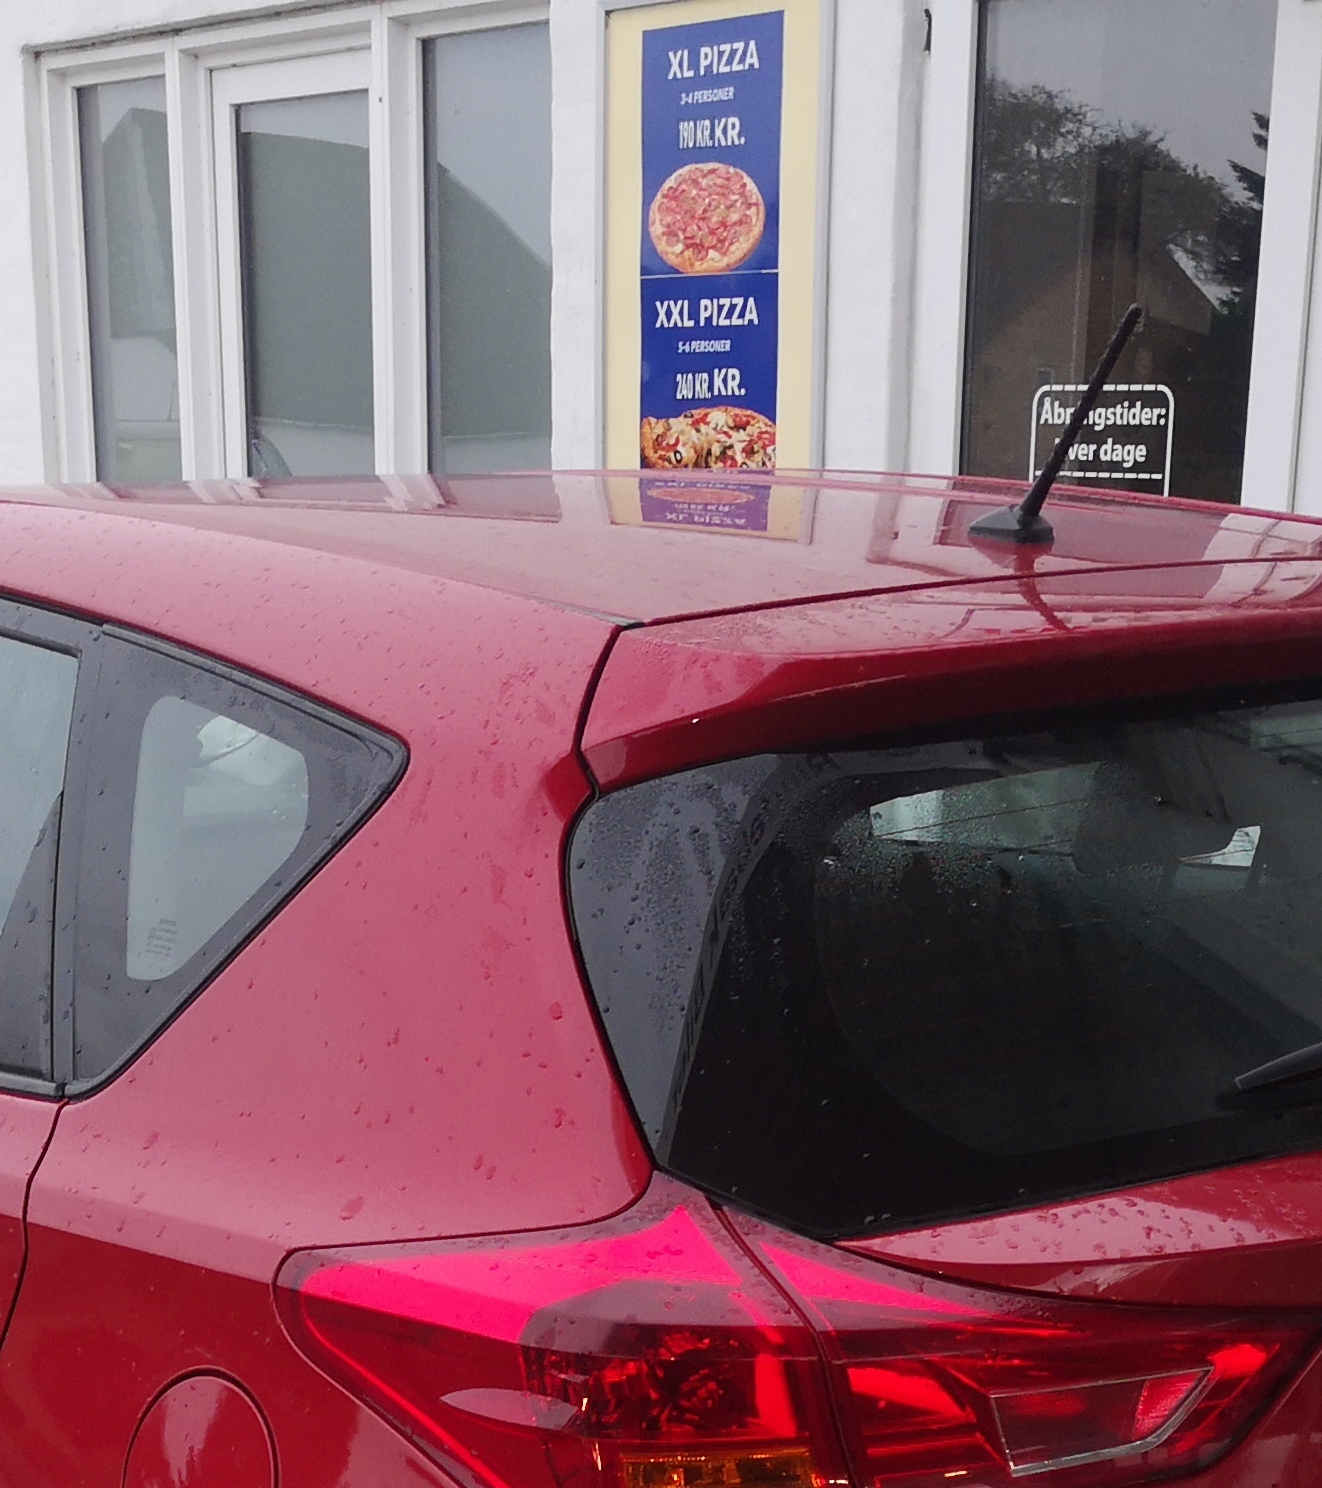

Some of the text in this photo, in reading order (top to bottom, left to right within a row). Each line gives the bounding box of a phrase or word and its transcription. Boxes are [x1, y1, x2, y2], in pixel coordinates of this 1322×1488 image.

[667, 40, 760, 80] XL PIZZA
[693, 86, 735, 104] PERSONER
[679, 116, 746, 149] 190 KR. KR.
[655, 296, 759, 328] XXL PIZZA
[690, 339, 731, 353] PERSONER
[675, 367, 746, 400] 240 KR. KR.
[1099, 437, 1147, 468] dage
